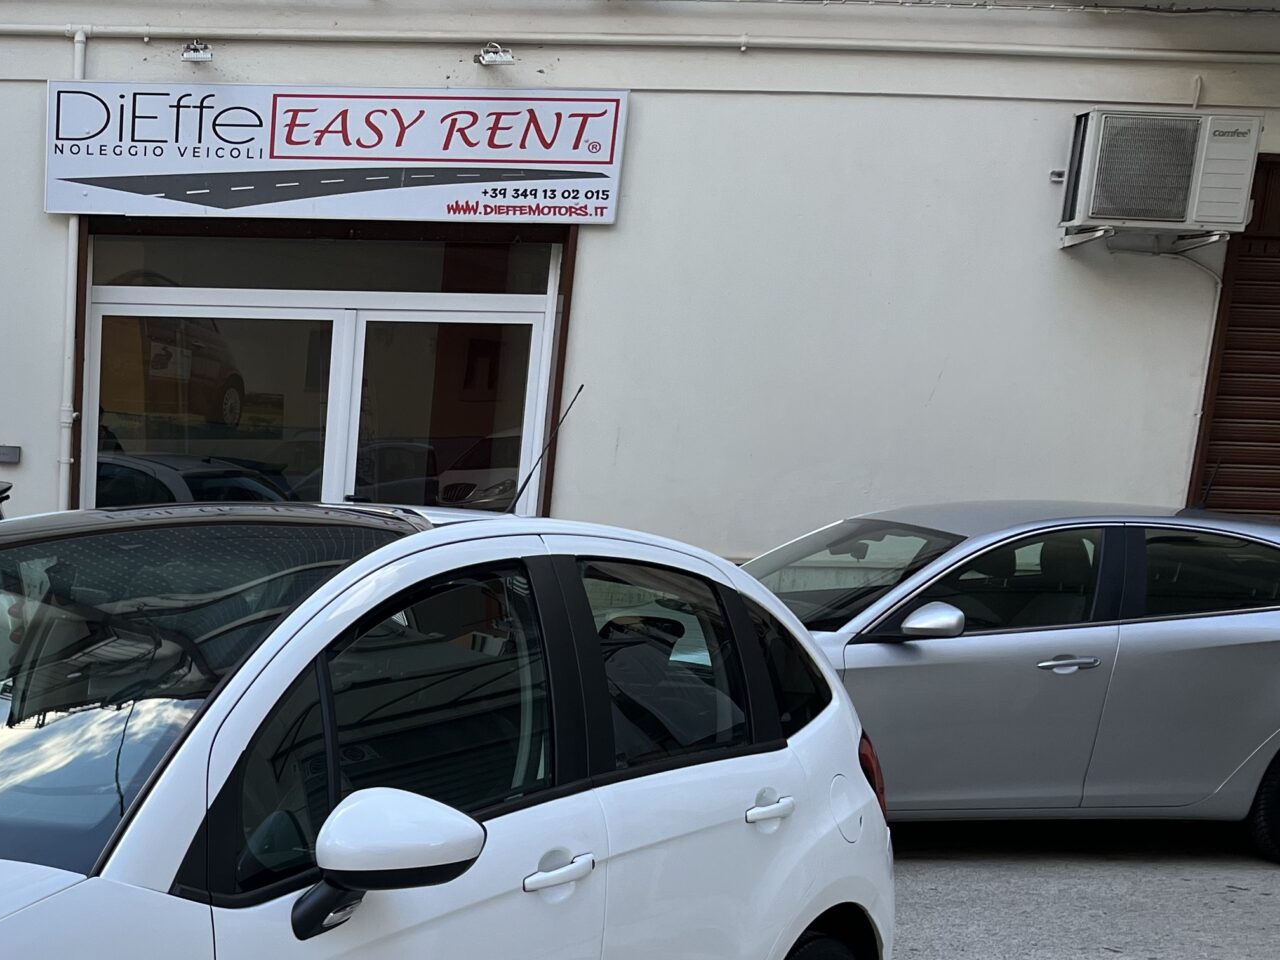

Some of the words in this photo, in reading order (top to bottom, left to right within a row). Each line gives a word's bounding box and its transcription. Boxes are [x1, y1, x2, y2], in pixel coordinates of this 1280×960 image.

[54, 90, 264, 145] DiEffe
[283, 107, 426, 149] EASY
[440, 108, 608, 151] RENT
[54, 143, 164, 157] NOLEGGIO
[177, 146, 263, 159] VEICOLI
[481, 188, 507, 199] +39
[511, 188, 538, 200] 349
[542, 189, 557, 200] 13
[561, 189, 580, 200] 02
[584, 189, 610, 201] 015
